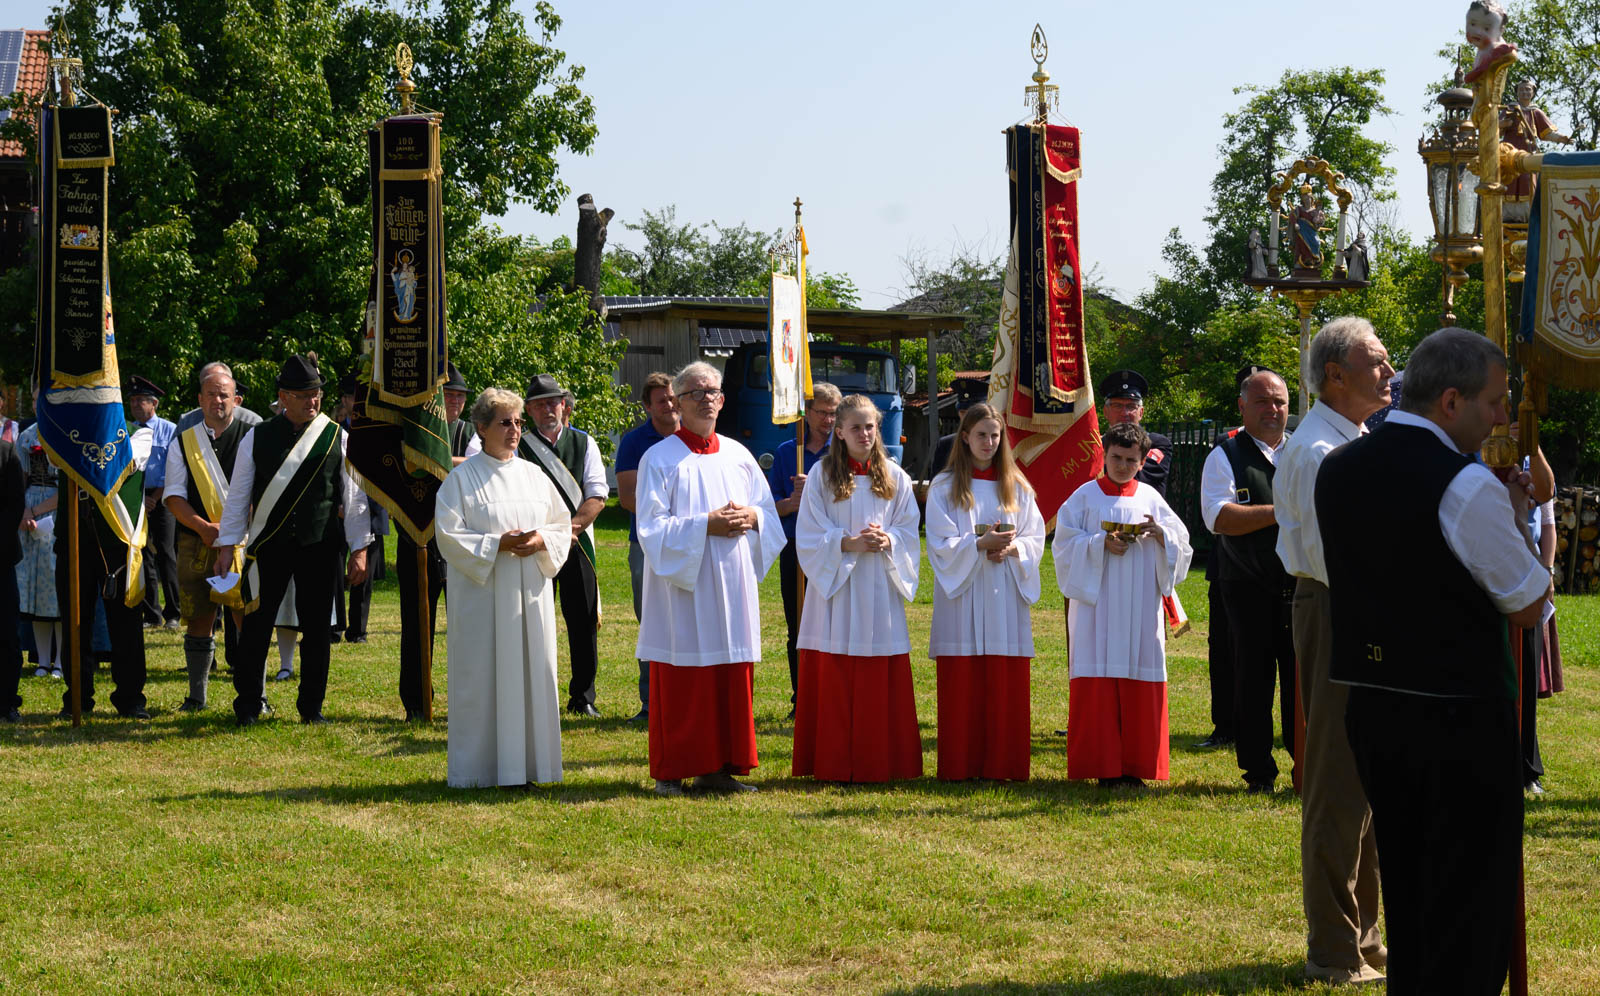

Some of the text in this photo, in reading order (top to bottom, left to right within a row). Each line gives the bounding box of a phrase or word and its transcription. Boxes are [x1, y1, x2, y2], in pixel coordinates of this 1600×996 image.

[398, 137, 413, 145] 100
[72, 172, 89, 184] Zur
[66, 200, 94, 214] weihe
[63, 259, 97, 268] gewidmet
[393, 357, 417, 368] Riedl
[1061, 457, 1080, 479] AM
